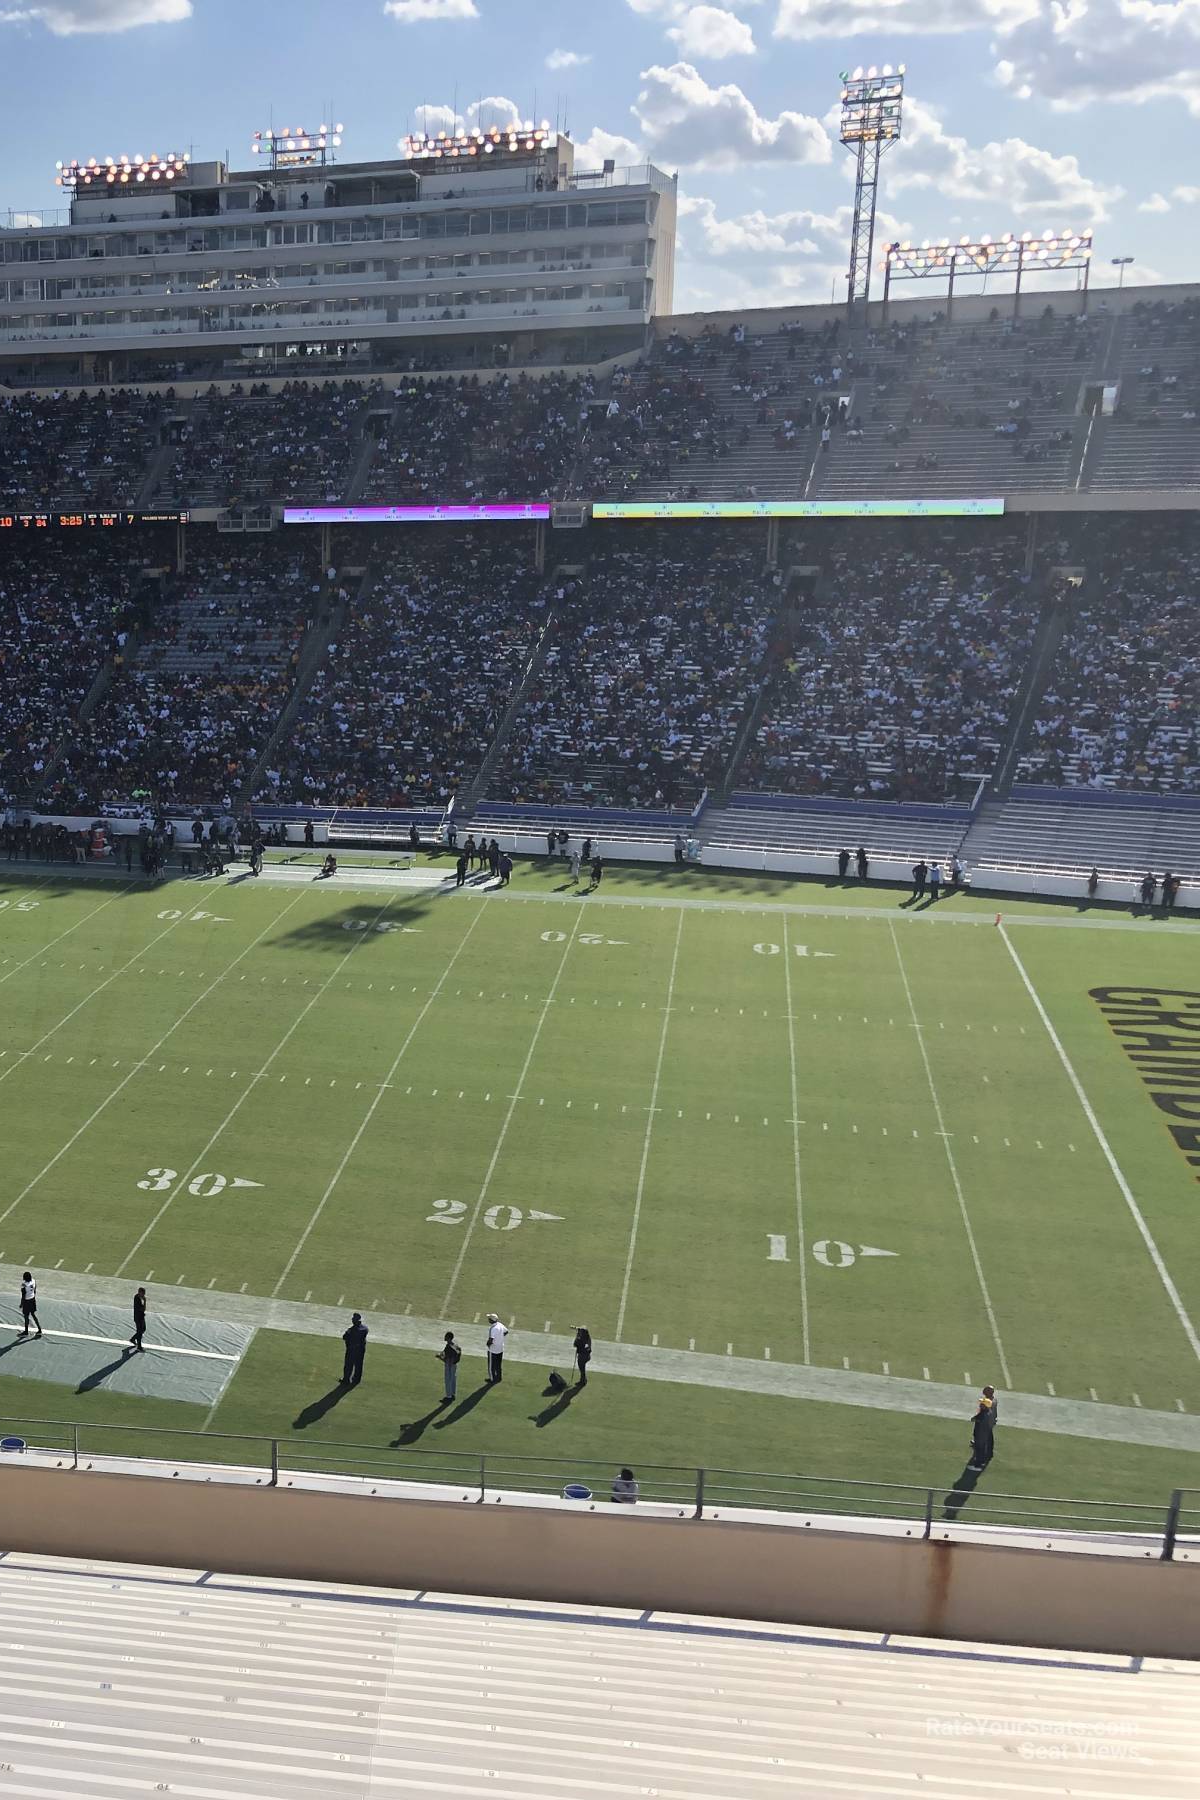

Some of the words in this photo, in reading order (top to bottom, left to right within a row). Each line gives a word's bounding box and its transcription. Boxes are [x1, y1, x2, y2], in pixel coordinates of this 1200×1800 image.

[0, 517, 12, 527] 10
[60, 515, 83, 526] 3:25
[127, 515, 134, 525] 7
[137, 1168, 227, 1196] 30
[426, 1199, 523, 1231] 20
[766, 1234, 856, 1268] 10
